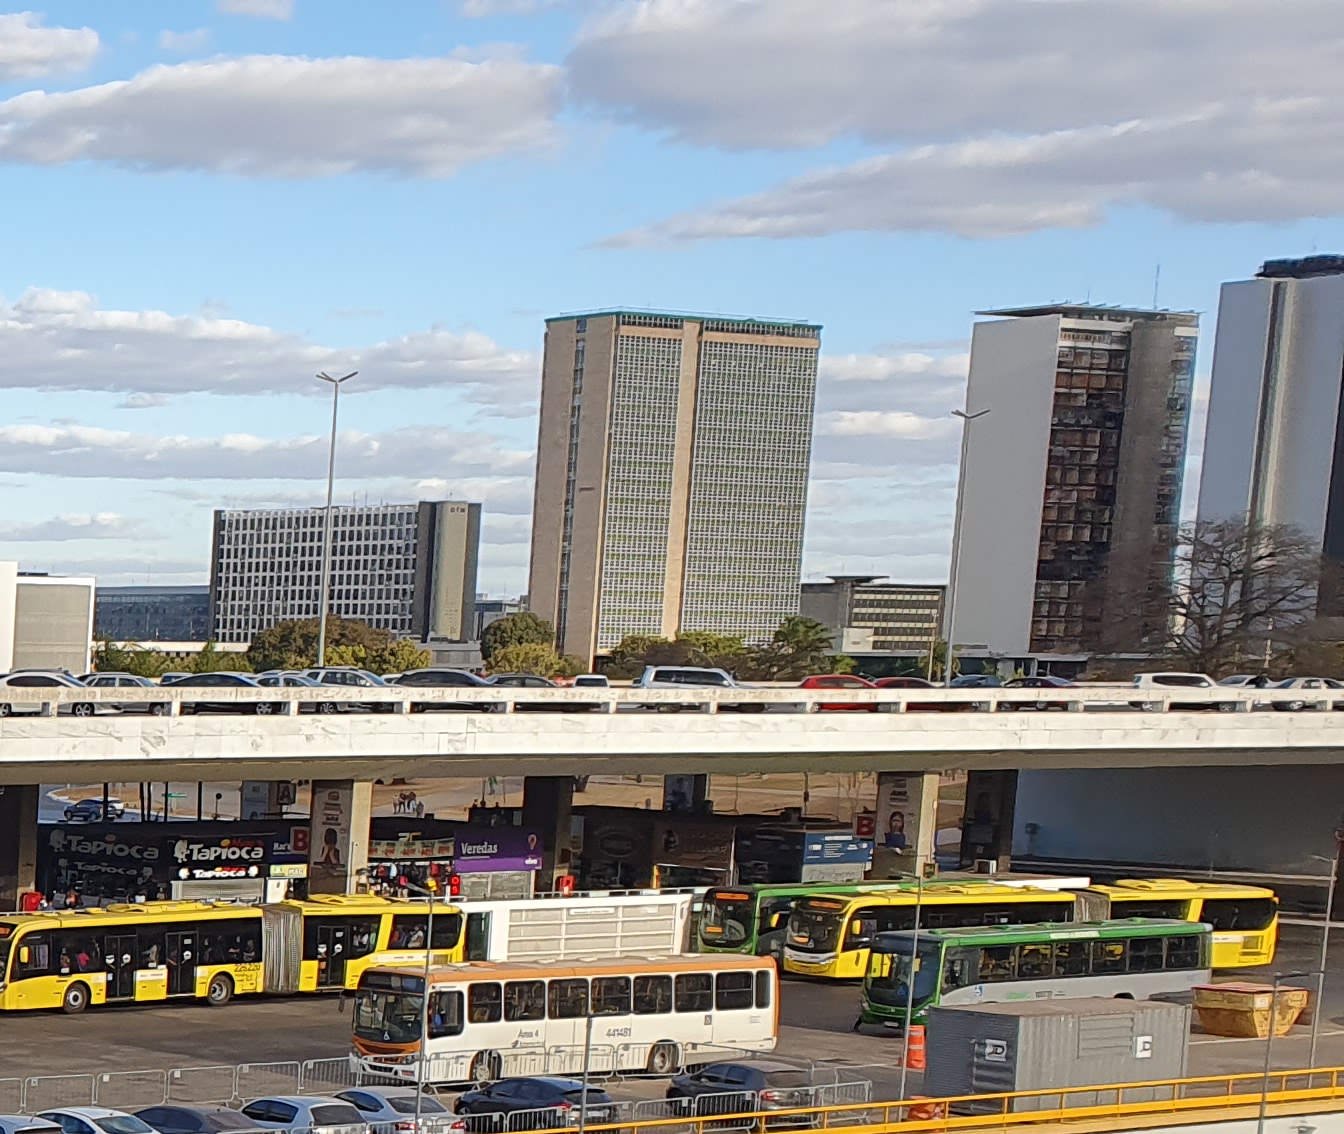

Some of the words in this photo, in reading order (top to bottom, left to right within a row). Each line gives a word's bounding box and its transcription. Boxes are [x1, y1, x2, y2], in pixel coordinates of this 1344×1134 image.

[857, 815, 874, 837] B
[293, 829, 308, 850] B
[461, 842, 498, 855] Veredas
